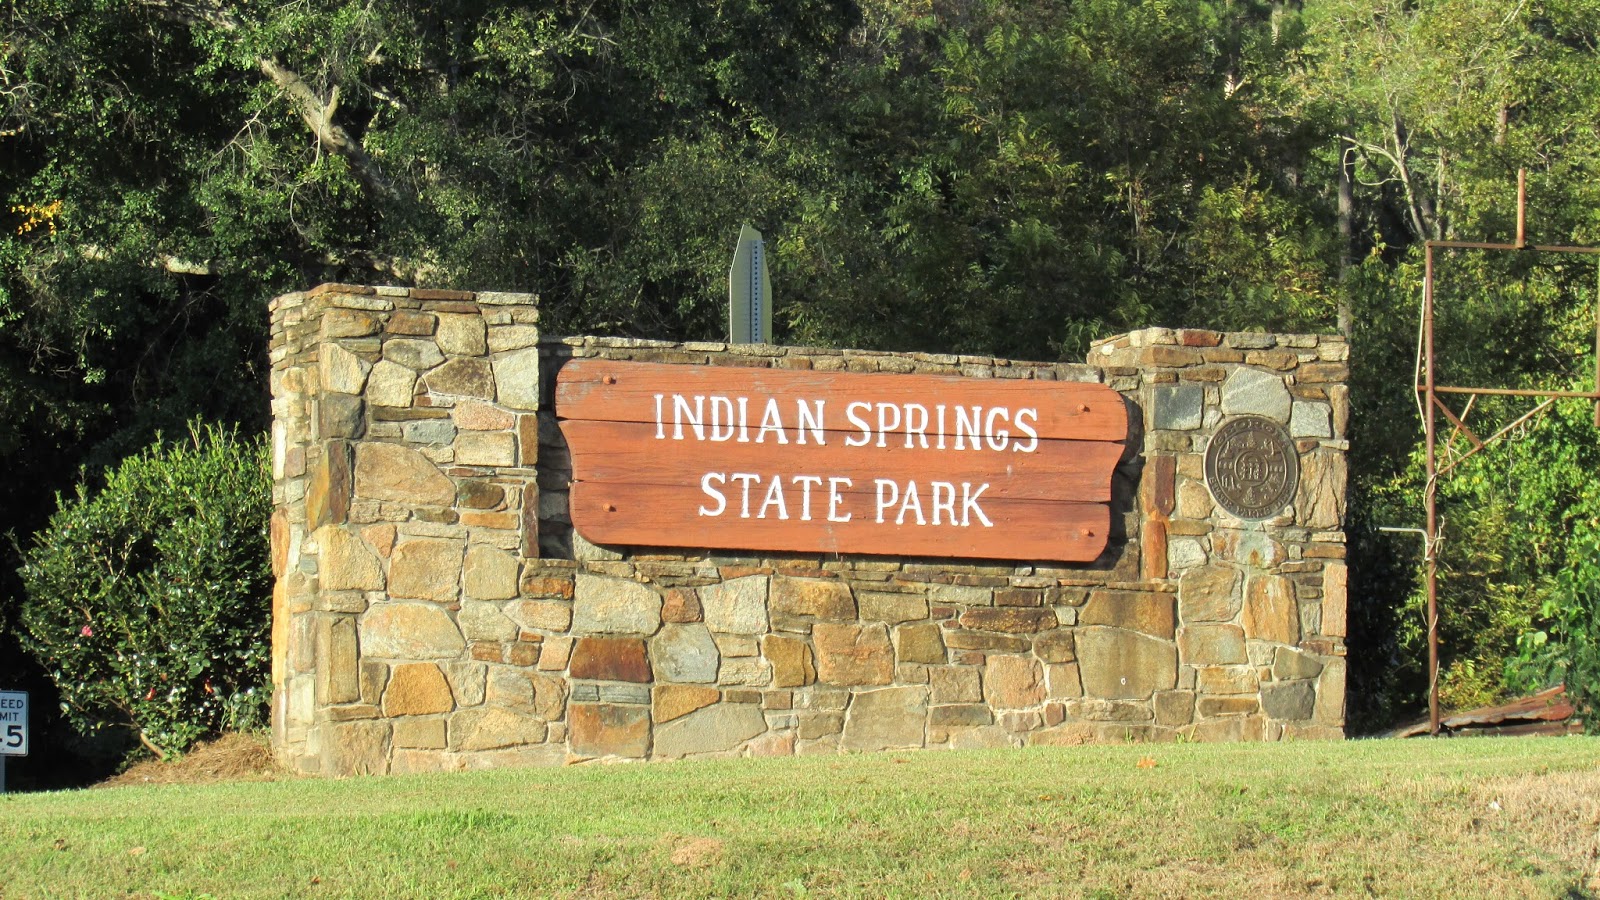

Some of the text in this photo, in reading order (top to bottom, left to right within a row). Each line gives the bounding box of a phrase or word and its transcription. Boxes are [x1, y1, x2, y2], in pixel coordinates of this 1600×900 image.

[653, 393, 1039, 453] INDIAN SPRINGS
[698, 471, 994, 528] STATE PARK
[0, 698, 24, 709] EED
[0, 711, 20, 722] MIT
[0, 724, 24, 748] 5
